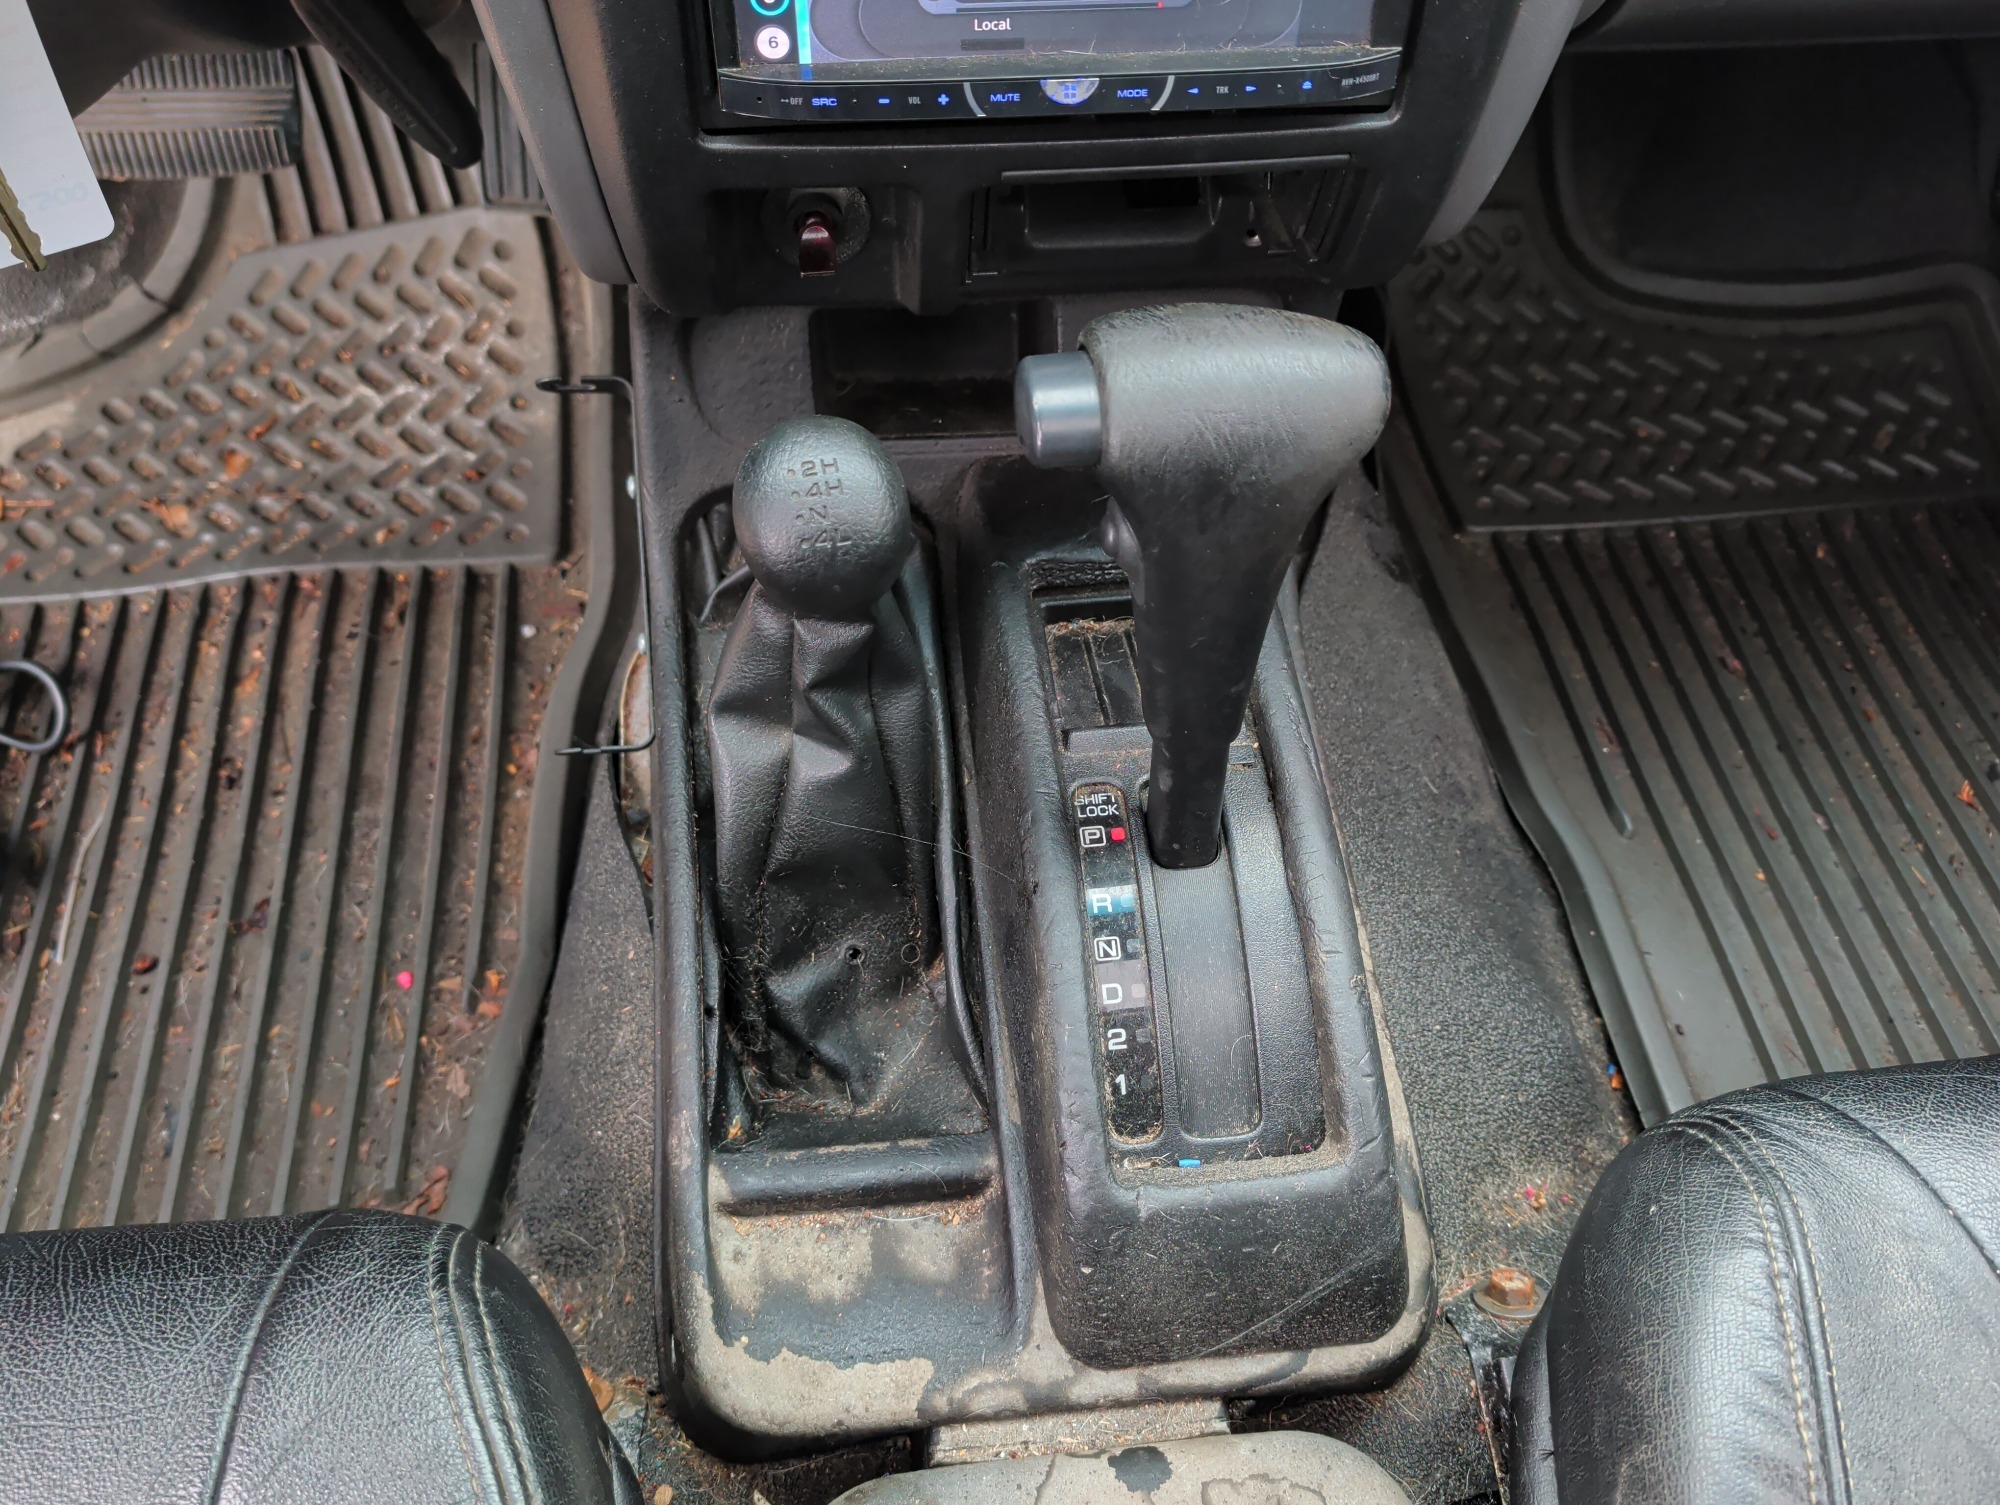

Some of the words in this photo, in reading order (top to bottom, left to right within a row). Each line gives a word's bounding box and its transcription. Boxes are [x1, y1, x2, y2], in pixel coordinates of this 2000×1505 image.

[974, 18, 1011, 31] Local
[768, 36, 780, 49] 6
[990, 93, 1021, 102] MUTE
[1117, 88, 1148, 98] MODE
[1216, 86, 1229, 94] TRK
[790, 97, 803, 105] OFF
[811, 98, 838, 106] SRC
[908, 96, 921, 105] VOL
[801, 457, 839, 478] 2H
[805, 478, 844, 497] 4H
[808, 504, 832, 524] N
[1074, 792, 1116, 806] SHIFT
[1077, 803, 1119, 818] LOCK
[1084, 829, 1101, 845] P
[1091, 893, 1113, 914] R
[1098, 939, 1118, 958] N
[1101, 983, 1123, 1005] D
[1107, 1028, 1127, 1050] 2
[1114, 1073, 1126, 1096] 1
